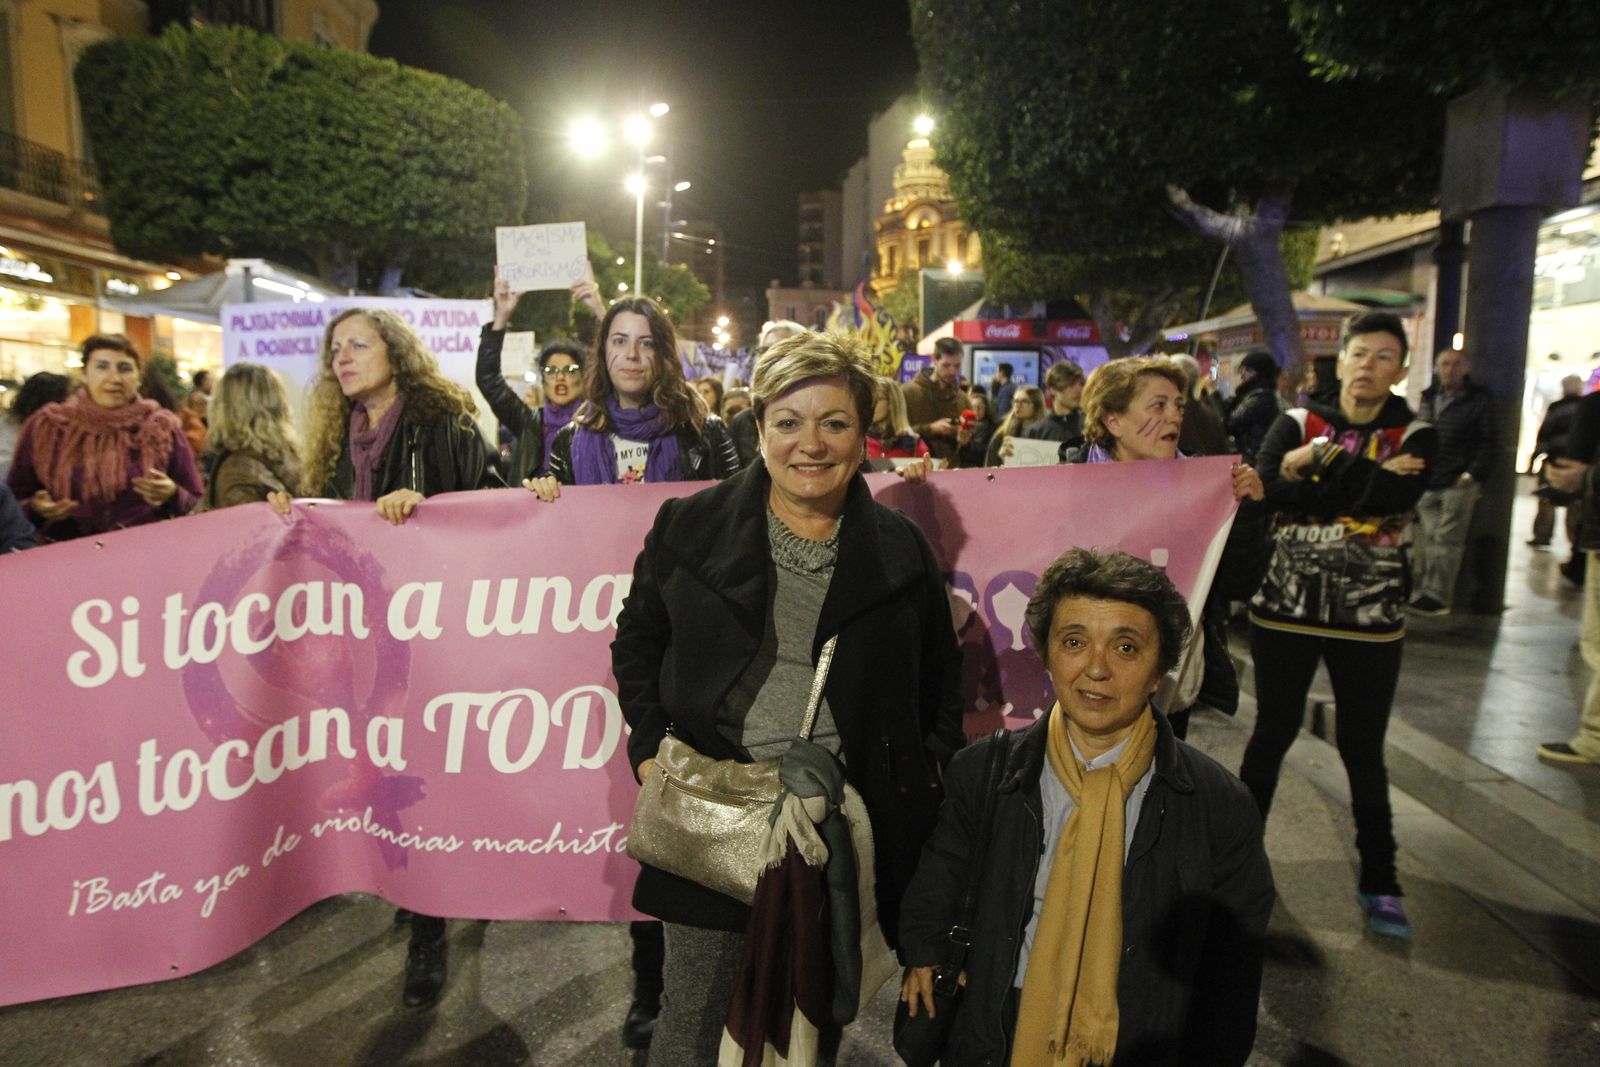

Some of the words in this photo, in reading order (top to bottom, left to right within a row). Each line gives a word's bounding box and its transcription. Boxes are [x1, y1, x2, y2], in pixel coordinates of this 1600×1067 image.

[420, 308, 479, 328] AYUDA
[239, 340, 249, 357] A
[256, 335, 322, 357] DOMICILI
[422, 331, 474, 353] UCÍA
[1301, 325, 1340, 342] OTOS
[620, 447, 634, 460] MY
[66, 595, 147, 688] Si
[161, 580, 370, 670] tocan
[387, 581, 444, 641] a
[466, 574, 634, 638] una
[0, 760, 121, 842] nos
[137, 707, 356, 817] tocan
[366, 715, 408, 772] a
[423, 684, 633, 774] TOD
[68, 870, 183, 917] ¡Basta
[193, 863, 250, 918] ya
[262, 825, 301, 867] de
[311, 805, 464, 853] violencias
